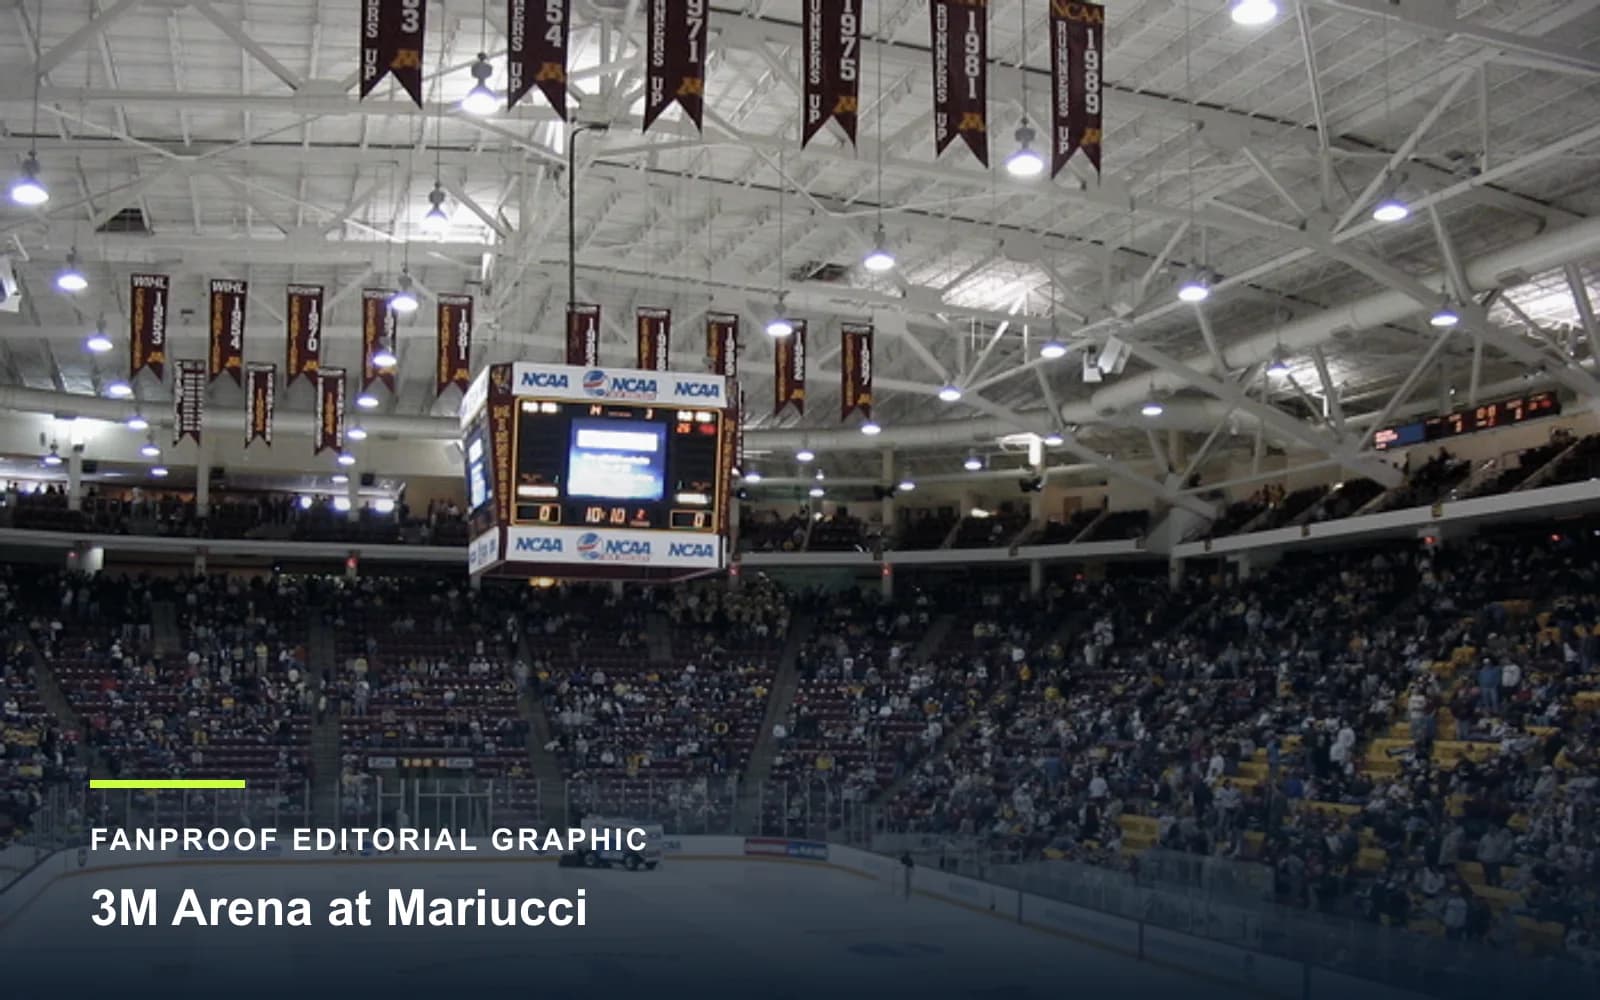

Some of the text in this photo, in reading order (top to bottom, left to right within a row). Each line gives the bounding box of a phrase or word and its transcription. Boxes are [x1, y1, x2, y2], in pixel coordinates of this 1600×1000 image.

[1052, 0, 1104, 24] NCAA
[365, 48, 378, 80] UP
[965, 11, 980, 99] 1981
[511, 63, 522, 92] UP
[937, 4, 948, 141] RUNNERS UP
[1084, 28, 1099, 115] 1989
[651, 77, 664, 106] UP
[1057, 21, 1069, 154] RUNNERS UP
[809, 94, 820, 123] UP
[152, 291, 164, 344] 1953
[230, 296, 241, 349] 1954
[307, 299, 319, 351] 1970
[521, 372, 569, 388] NCAA
[611, 377, 658, 393] NCAA
[674, 381, 720, 397] NCAA
[516, 537, 563, 552] NCAA
[605, 540, 652, 556] NCAA
[668, 542, 715, 558] NCAA
